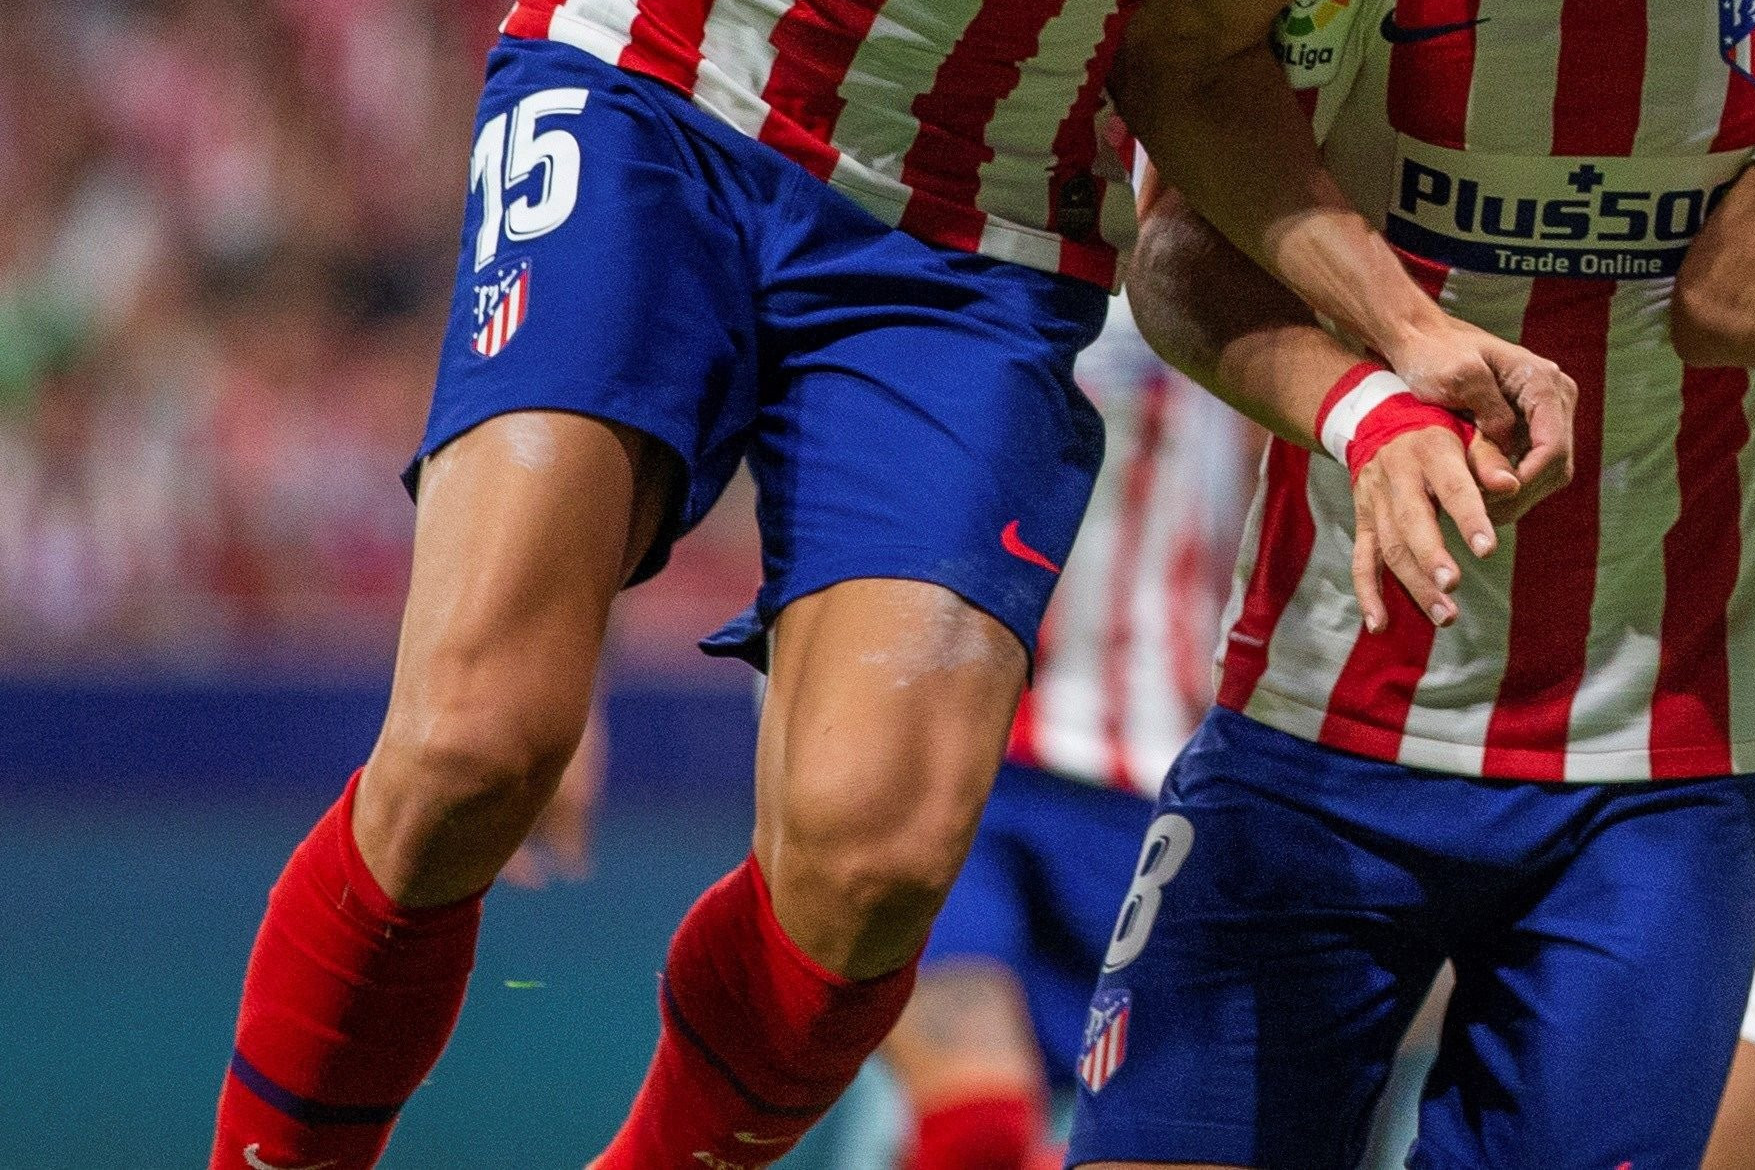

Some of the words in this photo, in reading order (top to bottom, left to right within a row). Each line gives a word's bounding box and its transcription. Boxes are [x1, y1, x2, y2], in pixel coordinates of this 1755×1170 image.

[1276, 41, 1334, 71] Liga
[470, 87, 590, 274] 15
[1495, 249, 1569, 274] Trade
[1580, 252, 1662, 275] Online
[1101, 812, 1195, 974] 8
